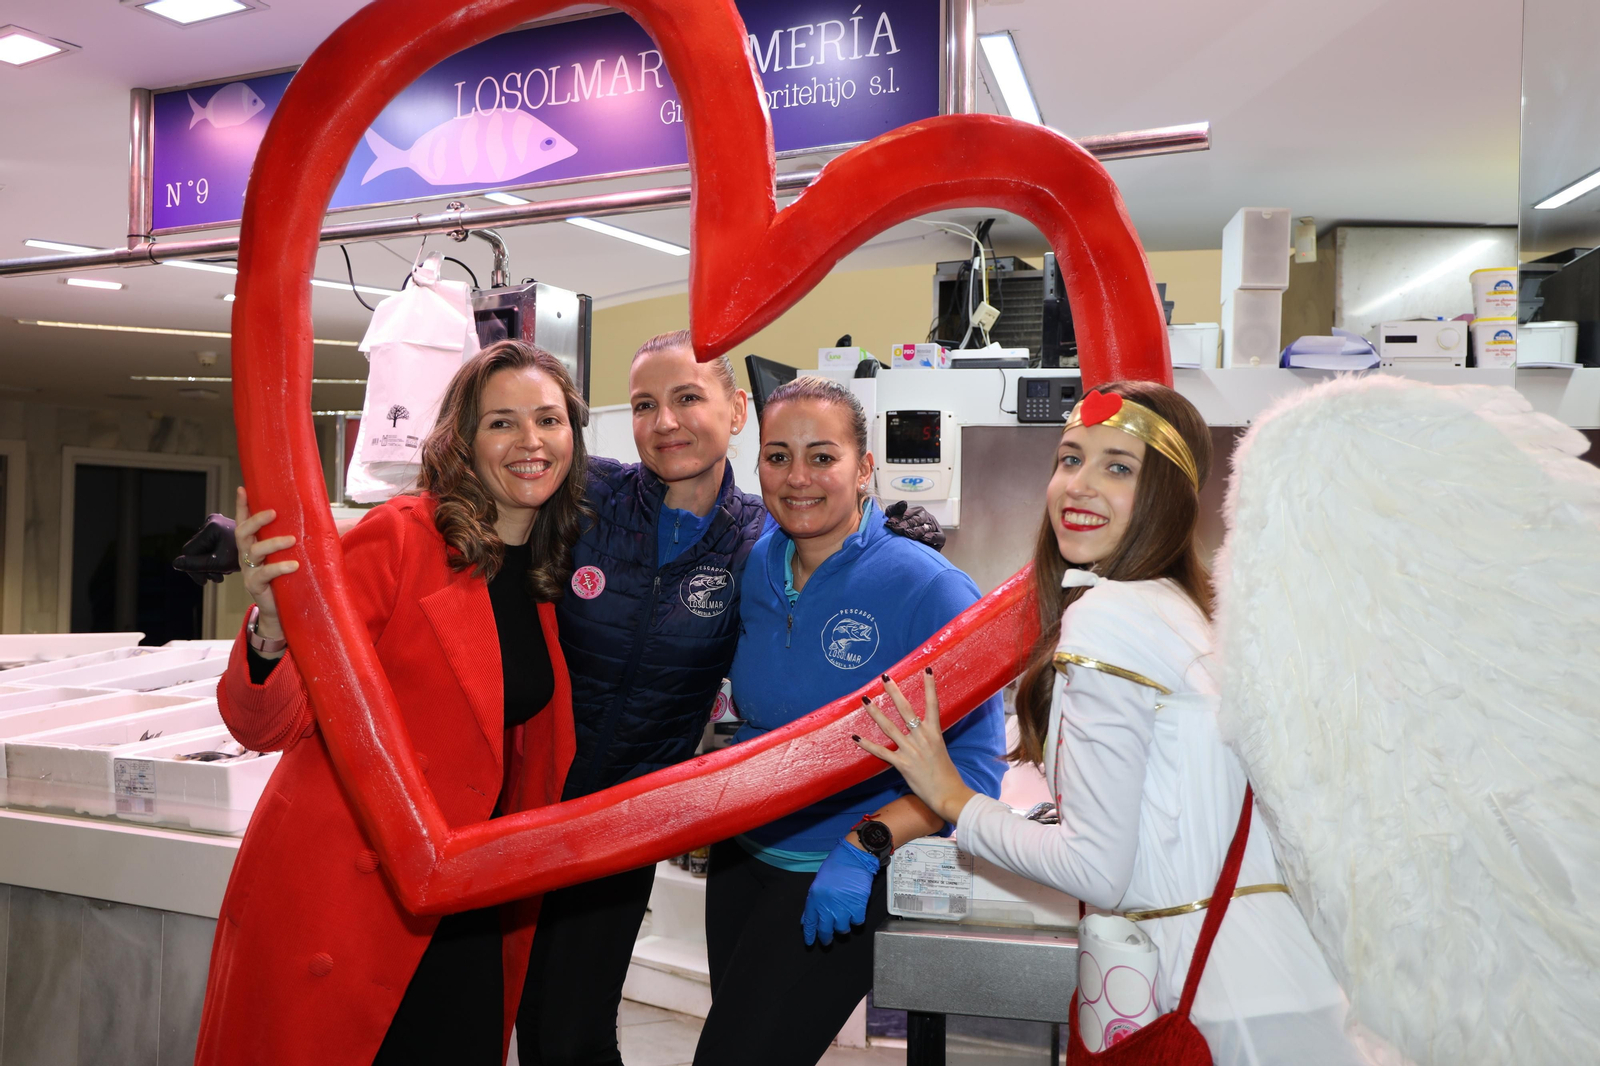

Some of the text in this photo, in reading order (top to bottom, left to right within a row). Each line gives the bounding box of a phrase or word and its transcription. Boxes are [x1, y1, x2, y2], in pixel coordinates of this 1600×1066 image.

[453, 4, 901, 120] LOSOLMAR MERÍA
[869, 67, 900, 96] s.l.
[689, 600, 724, 609] LOSOLMAR
[839, 608, 875, 622] PESCADOS
[828, 649, 862, 664] LOSOLMAR
